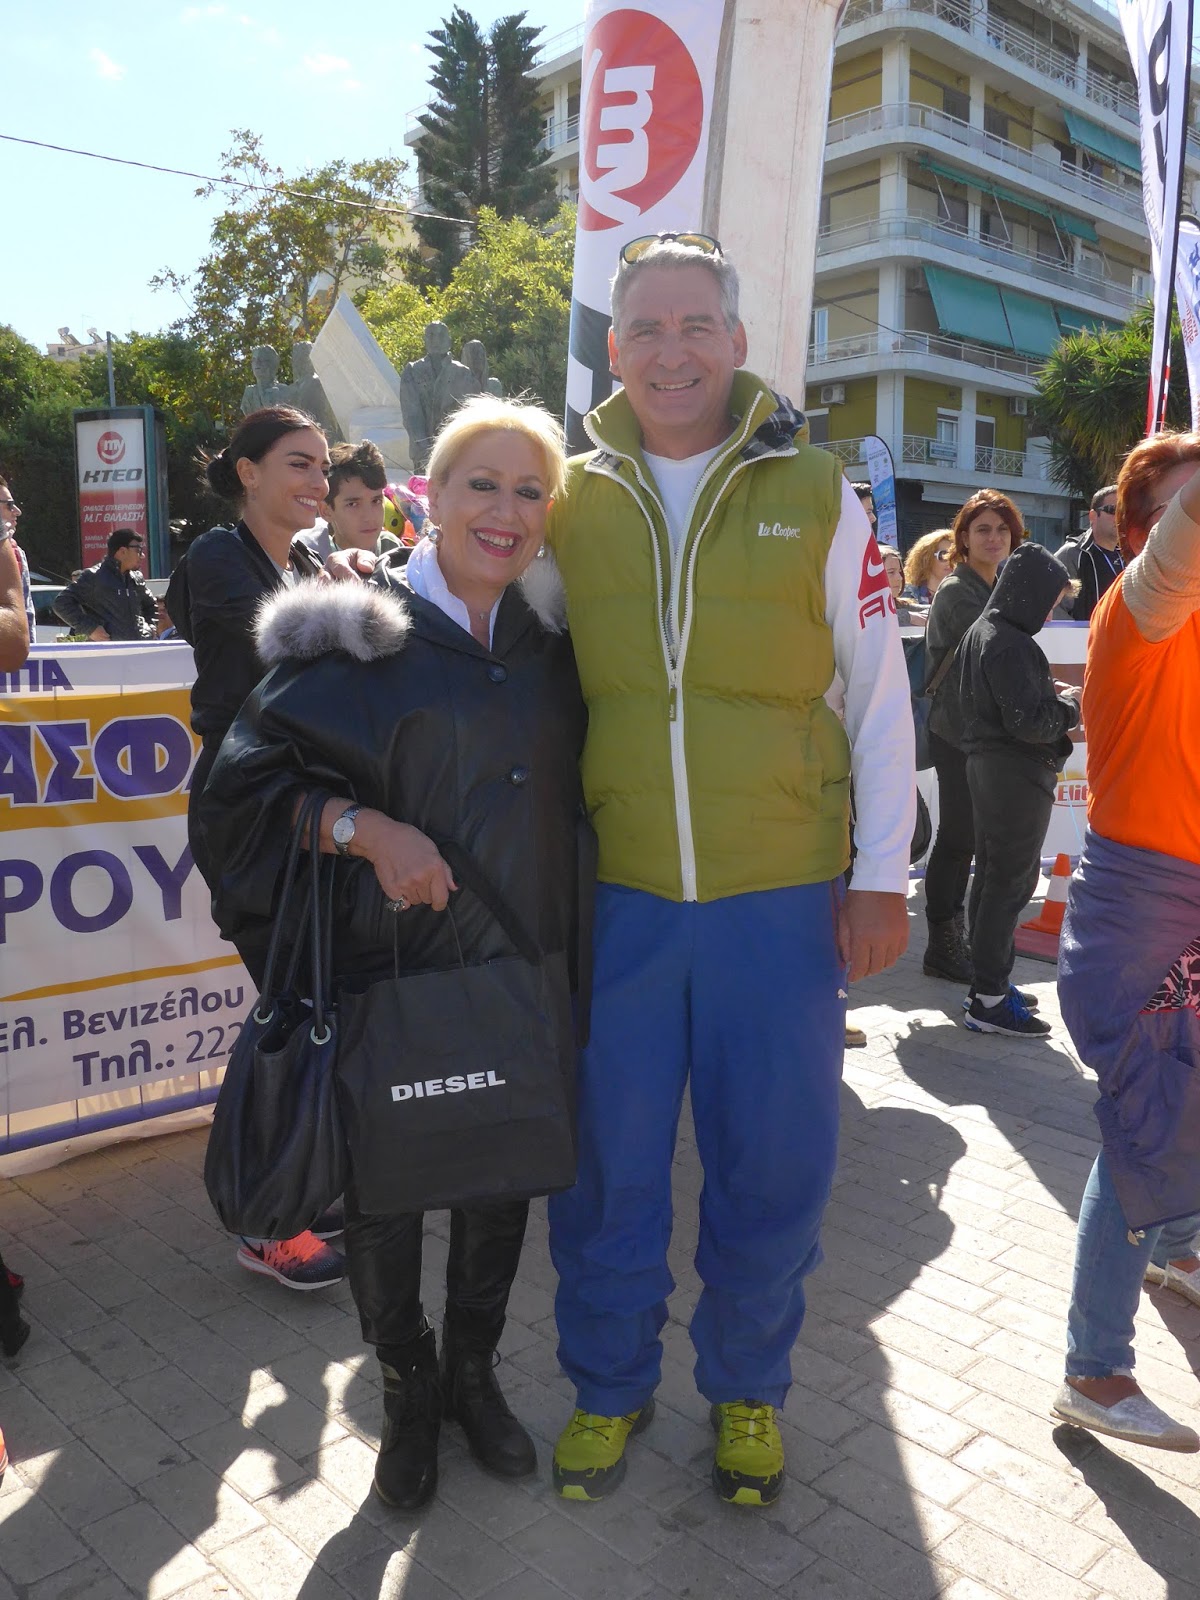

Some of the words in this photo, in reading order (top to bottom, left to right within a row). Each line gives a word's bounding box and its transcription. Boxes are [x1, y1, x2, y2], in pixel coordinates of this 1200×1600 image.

[103, 511, 145, 522] ΘΑΛΑΣΣΗ
[772, 522, 801, 540] Cooper
[0, 714, 202, 807] ΑΣΦ
[63, 985, 244, 1040] Βενιζέλου
[73, 1039, 175, 1087] Τηλ.:
[390, 1069, 507, 1102] DIESEL
